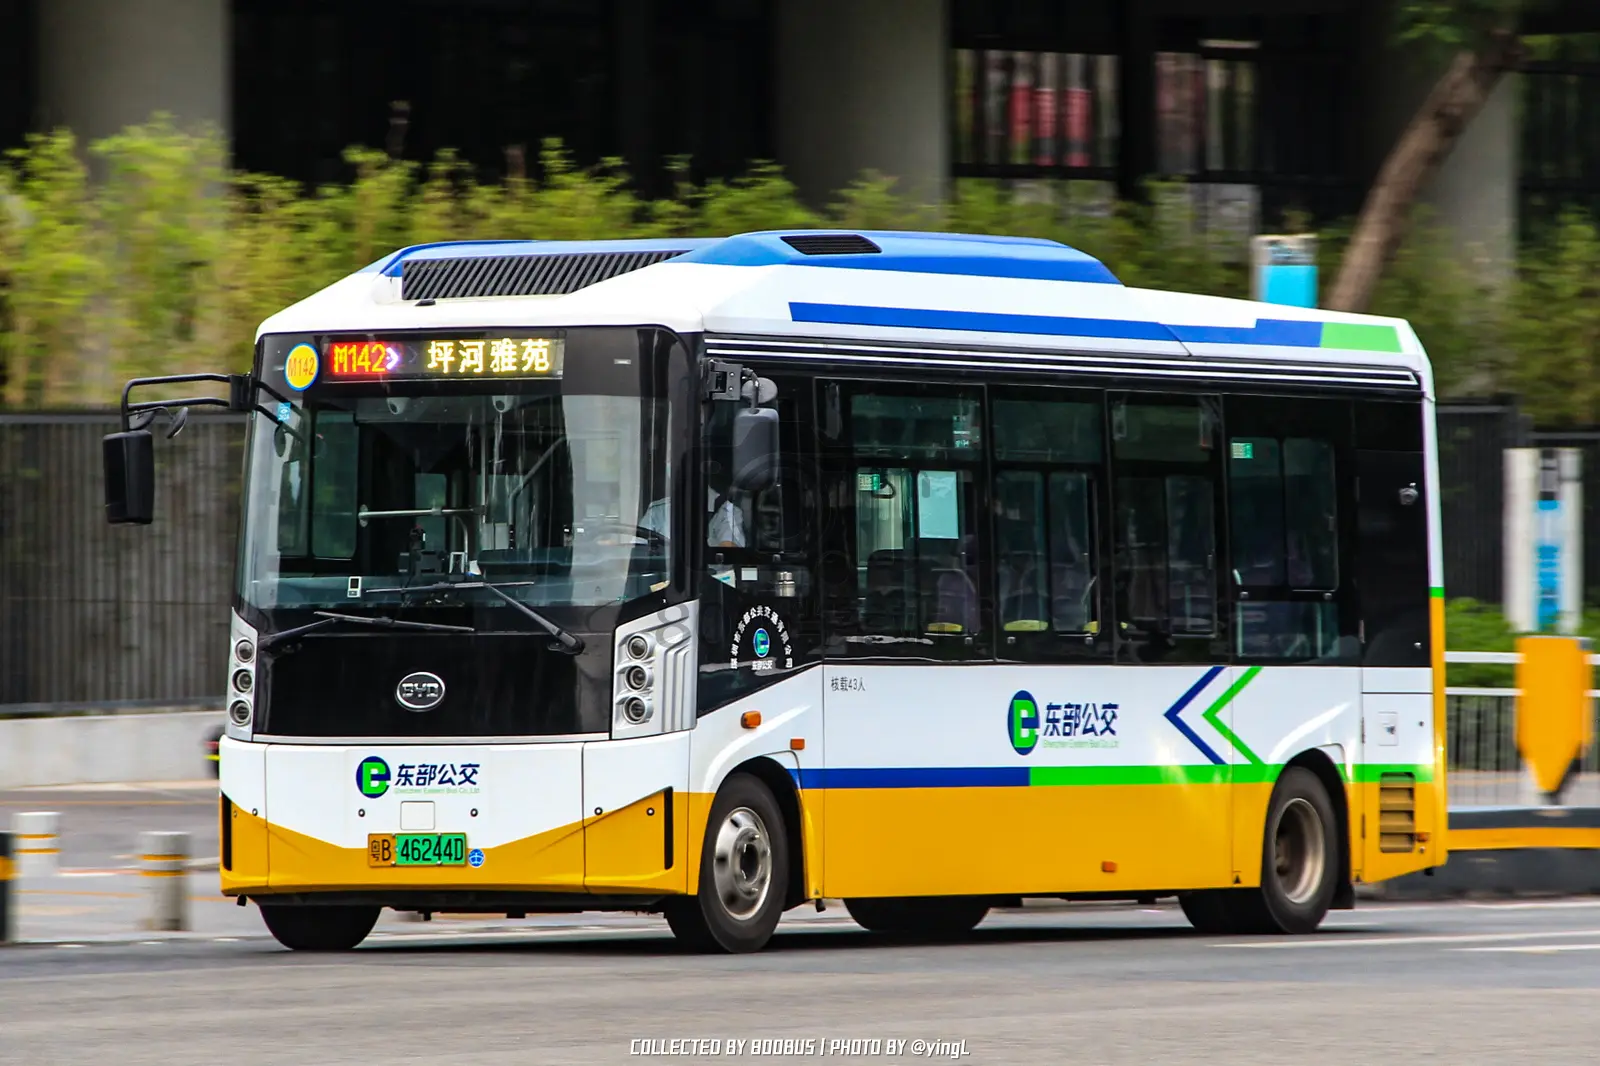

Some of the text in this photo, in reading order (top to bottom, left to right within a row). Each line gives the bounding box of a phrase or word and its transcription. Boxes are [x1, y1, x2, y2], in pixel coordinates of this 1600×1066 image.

[333, 344, 386, 374] M142
[427, 338, 550, 373] 坪河雅苑
[288, 357, 316, 377] M142
[402, 683, 439, 697] BYD
[831, 676, 866, 691] 核载43人
[1043, 703, 1119, 736] 东部公交
[395, 764, 480, 786] 东部公交
